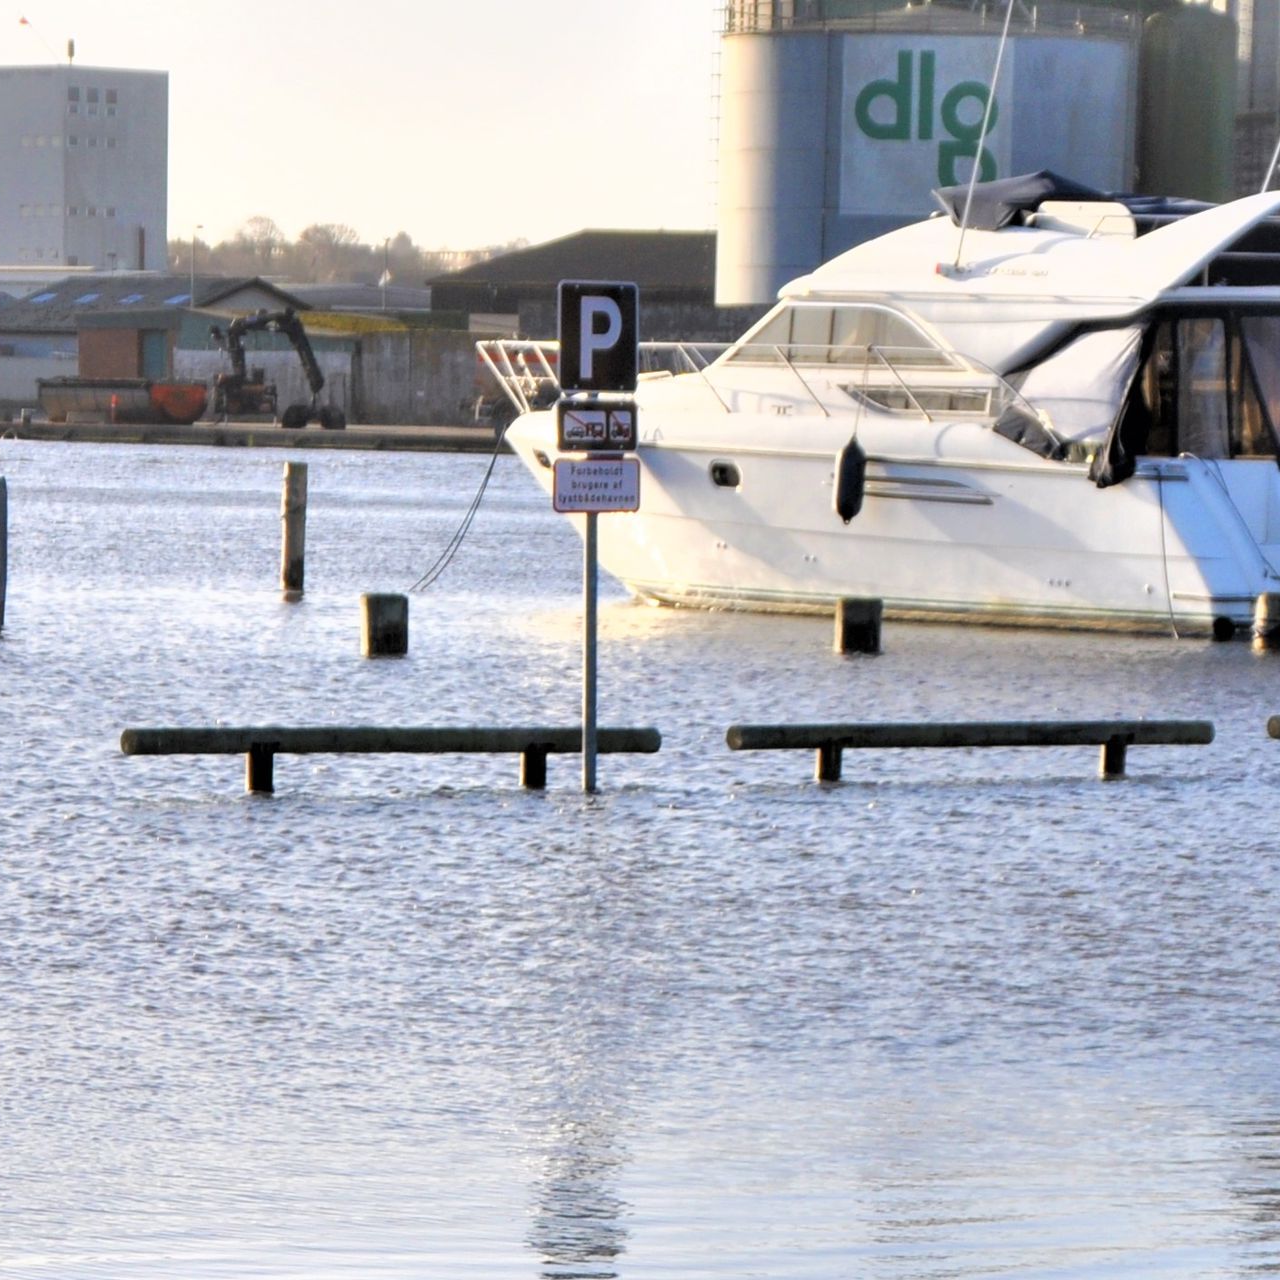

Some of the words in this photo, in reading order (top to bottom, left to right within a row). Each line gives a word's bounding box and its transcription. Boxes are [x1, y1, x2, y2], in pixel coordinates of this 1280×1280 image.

[854, 49, 999, 188] dlg
[580, 295, 622, 380] P
[570, 465, 624, 476] Forbeholdt
[571, 480, 609, 491] brugere
[613, 479, 623, 490] af
